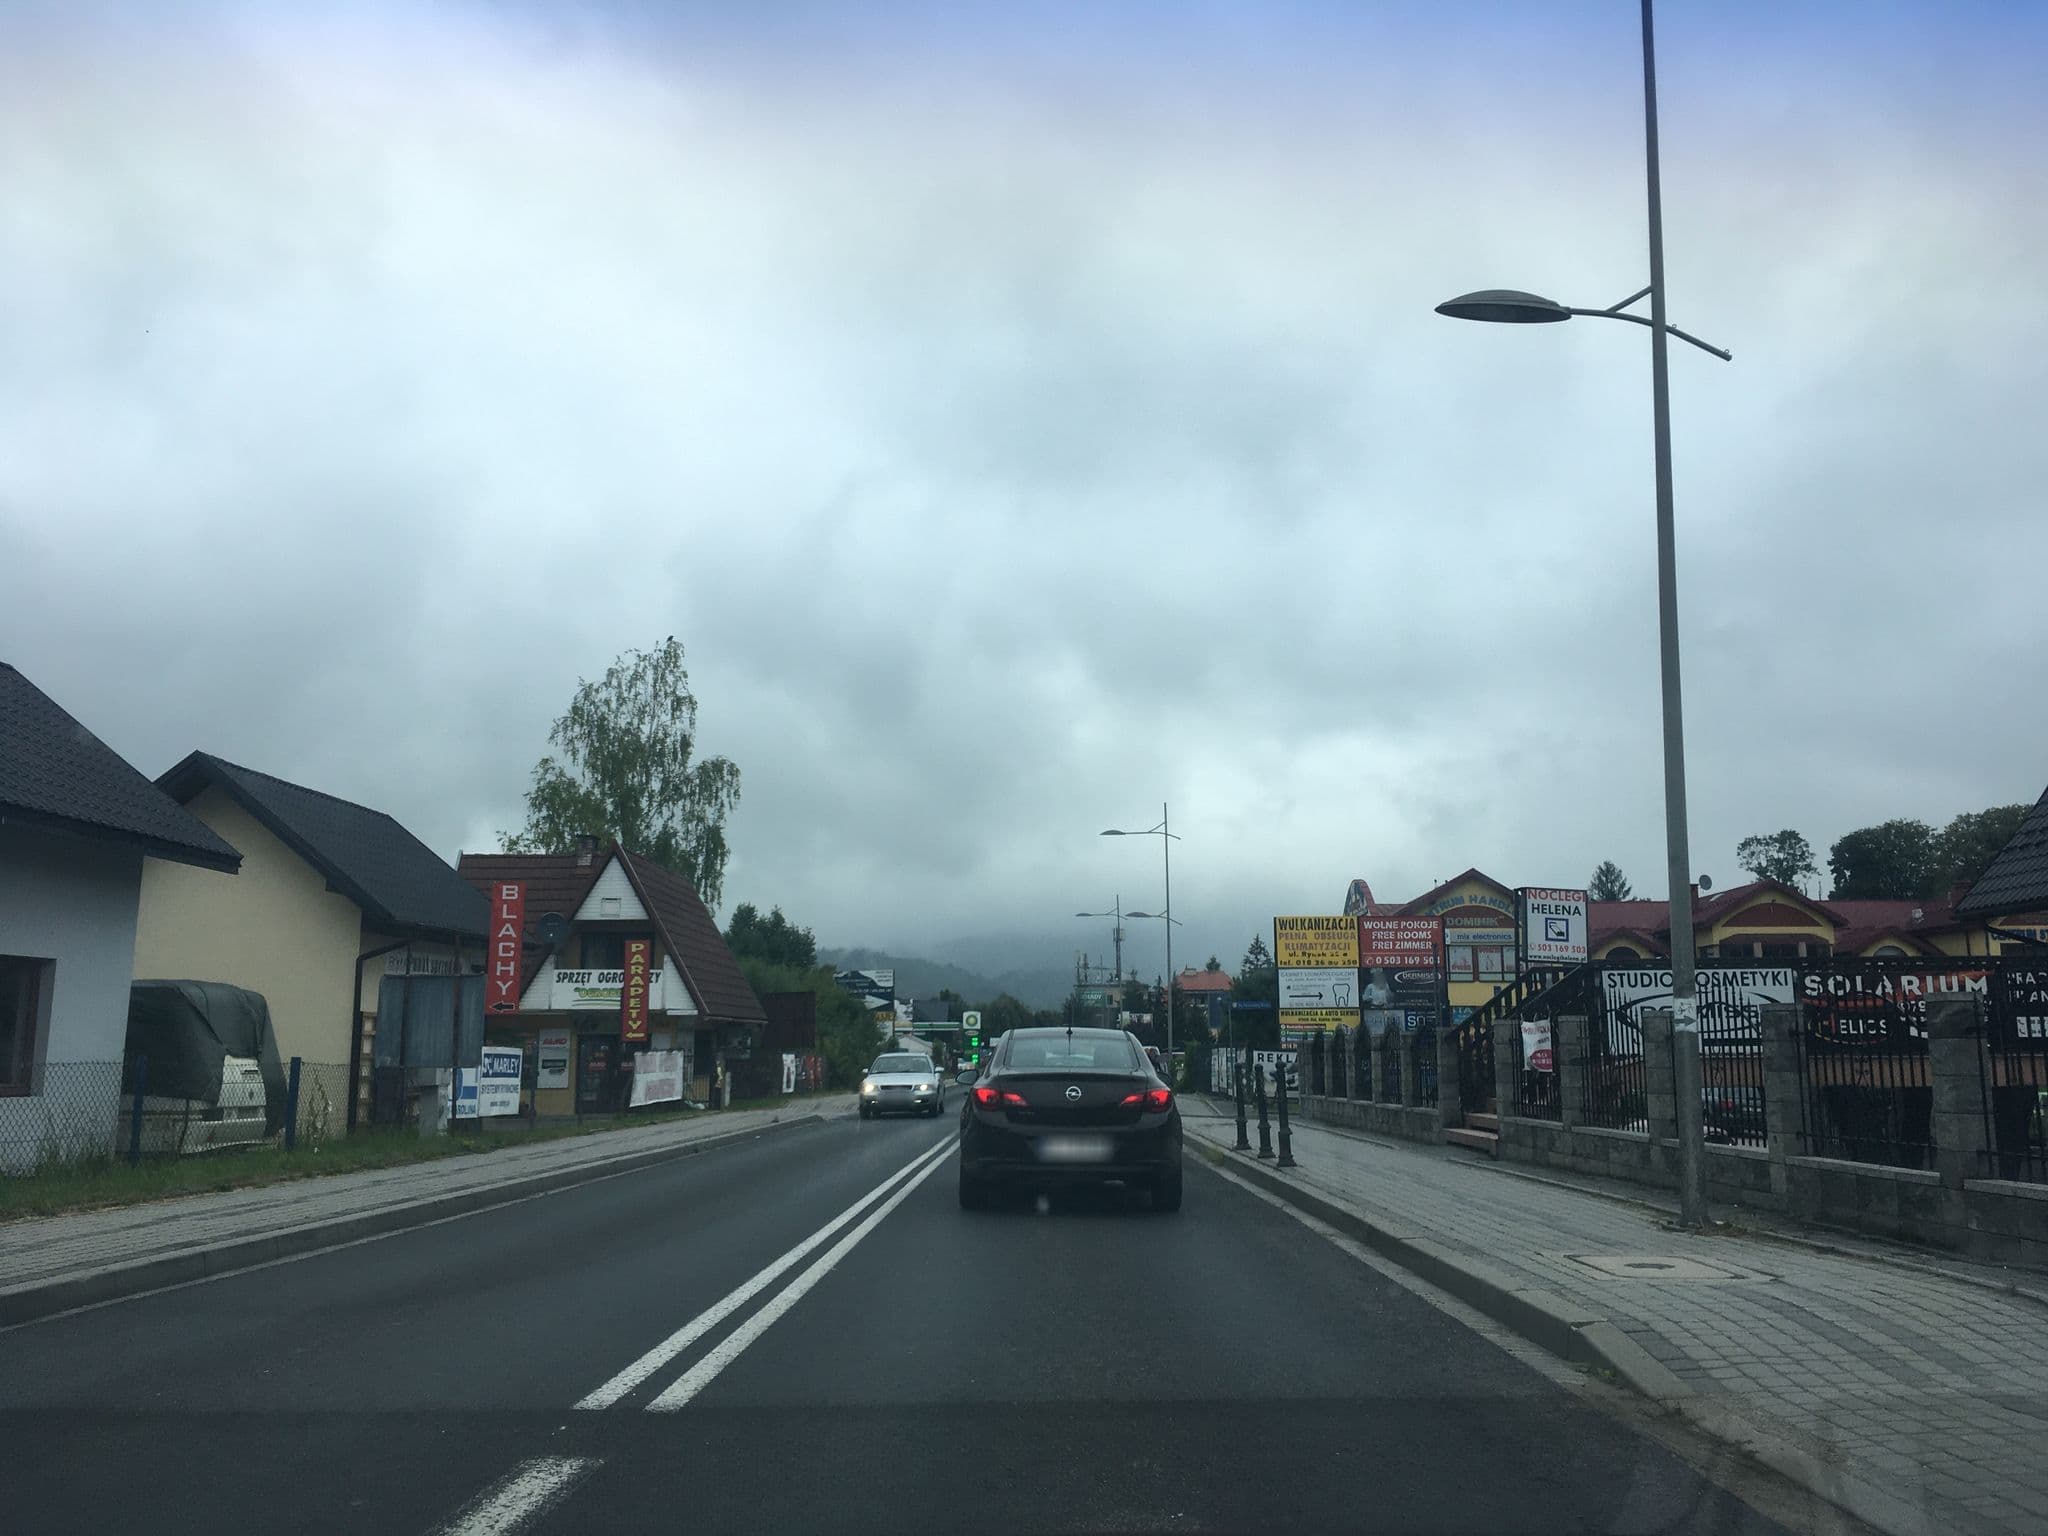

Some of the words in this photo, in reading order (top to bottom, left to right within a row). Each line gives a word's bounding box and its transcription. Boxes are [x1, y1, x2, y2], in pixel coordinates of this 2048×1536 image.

[1528, 890, 1586, 902] NOCLEGI
[1469, 895, 1515, 914] HANDL
[1531, 903, 1582, 916] HELENA
[1278, 918, 1356, 931] WULKANIZACJA
[1363, 921, 1399, 929] WOLNE
[1400, 921, 1439, 929] POKOJE
[496, 885, 519, 995] BLACHY
[1372, 931, 1395, 939] FREE
[1397, 931, 1432, 939] ROOMS
[1372, 941, 1393, 949] FREI
[1395, 941, 1432, 950] ZIMMER
[555, 972, 593, 986] SPRZĘT
[1607, 972, 1673, 988] STUDIO
[1695, 971, 1788, 987] OSMETYKI
[1803, 975, 1988, 996] SOLARIUM
[628, 943, 645, 1030] PARAPETY
